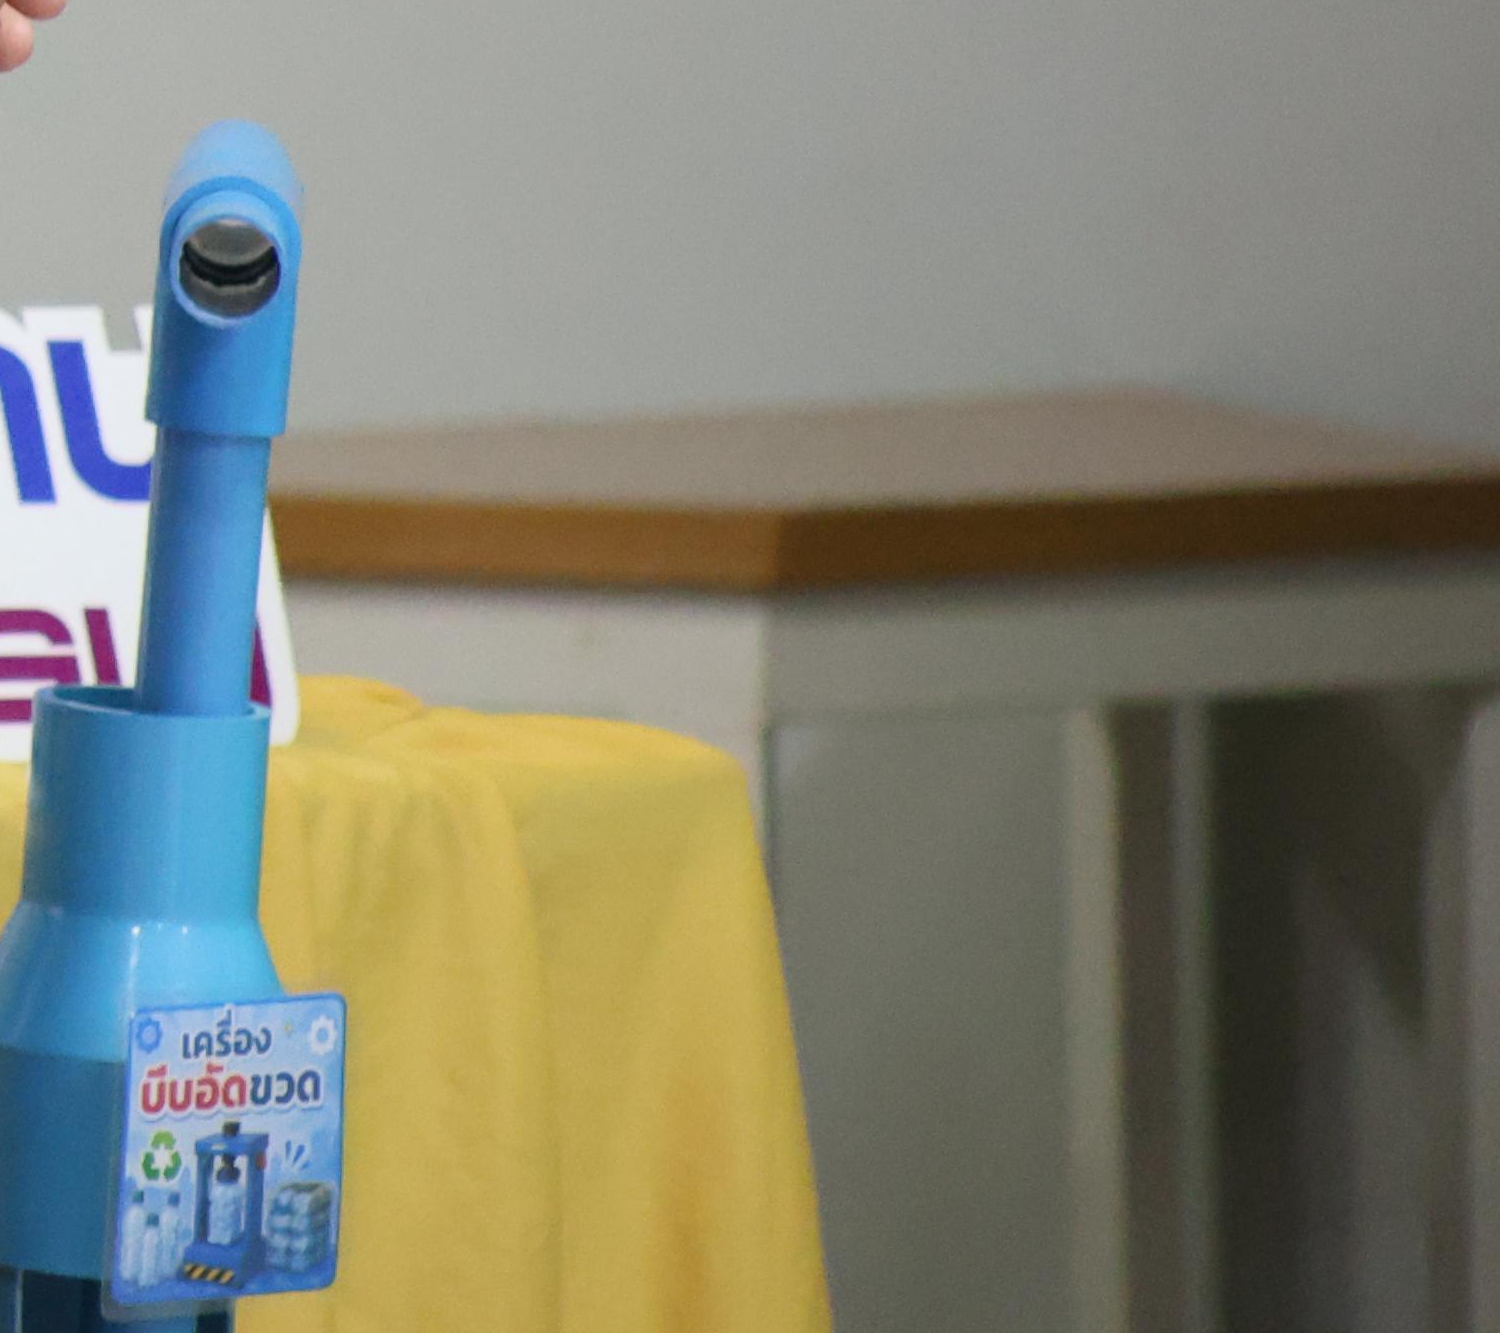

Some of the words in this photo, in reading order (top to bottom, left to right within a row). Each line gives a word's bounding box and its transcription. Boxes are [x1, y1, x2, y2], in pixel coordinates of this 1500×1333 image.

[181, 1008, 273, 1059] เครื่อง
[140, 1062, 322, 1114] บีบอัดขวด
